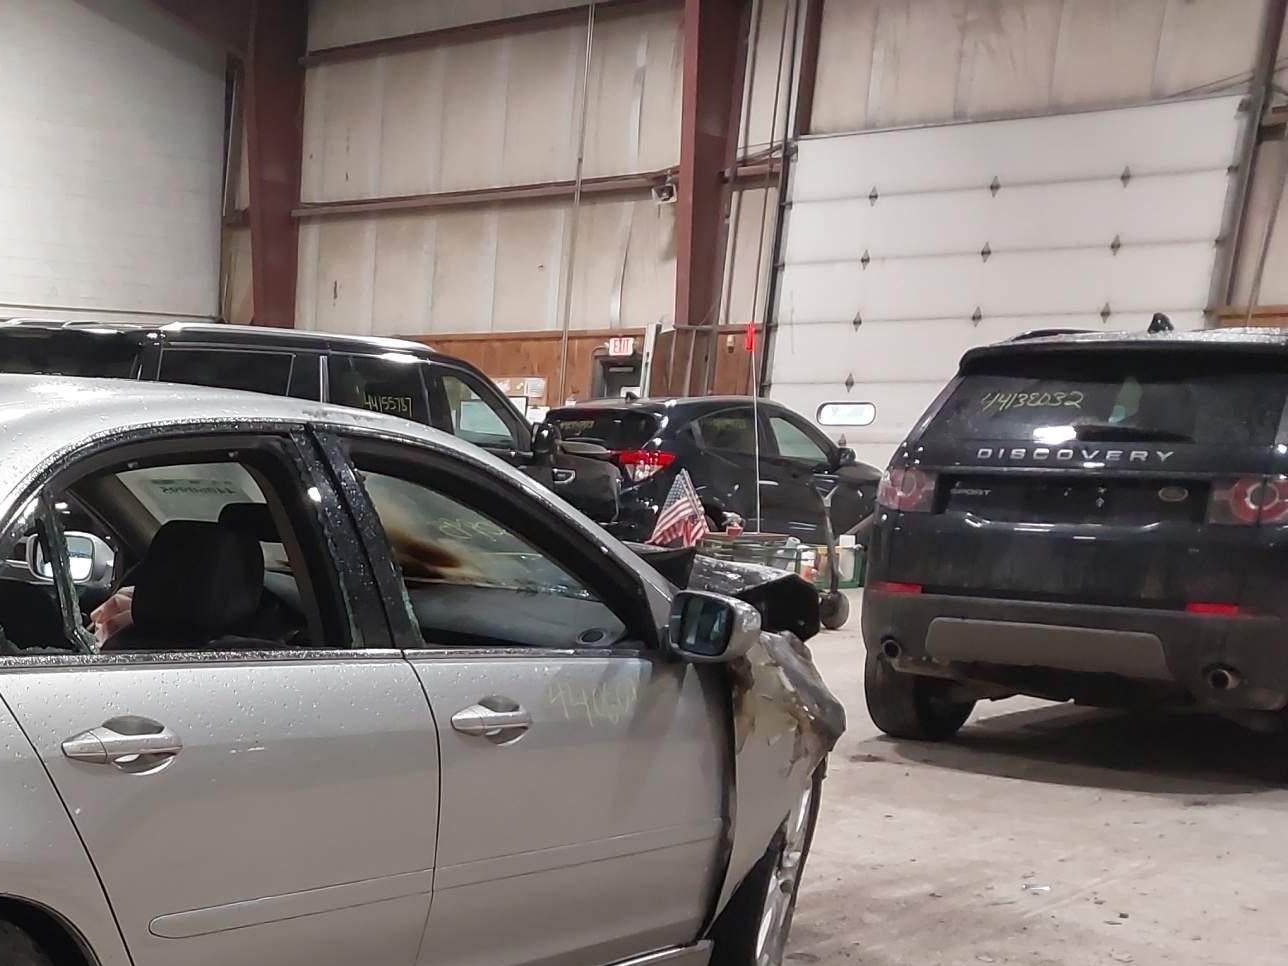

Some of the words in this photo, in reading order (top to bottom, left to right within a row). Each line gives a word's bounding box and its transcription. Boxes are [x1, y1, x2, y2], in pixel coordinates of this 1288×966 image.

[613, 339, 632, 353] EXIT
[976, 448, 1175, 462] DISCOVERY
[949, 488, 993, 496] SPORT
